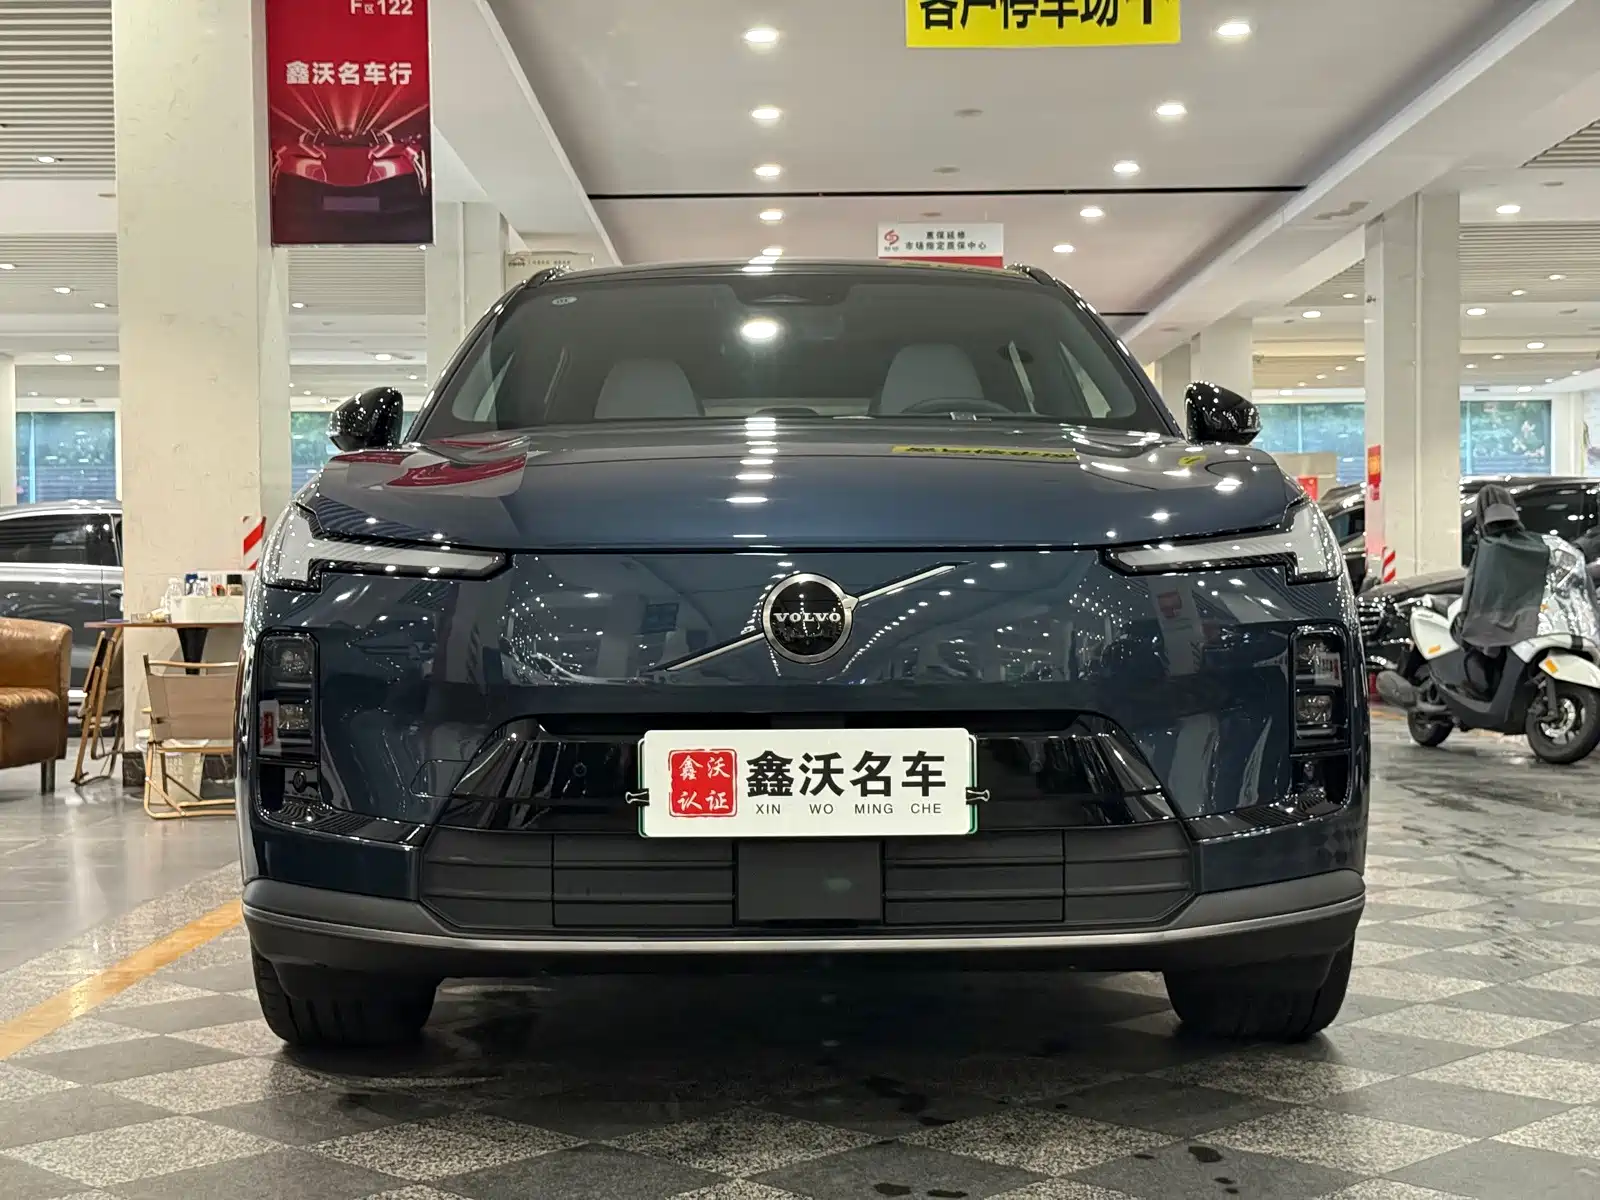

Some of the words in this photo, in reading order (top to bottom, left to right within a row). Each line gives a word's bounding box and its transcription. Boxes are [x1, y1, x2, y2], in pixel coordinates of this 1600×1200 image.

[286, 61, 413, 86] 鑫沃名车行
[773, 612, 841, 623] VOLVO
[679, 755, 731, 780] 鑫沃
[746, 750, 947, 798] 鑫沃名车
[677, 790, 730, 811] 认证
[756, 803, 781, 815] XIN
[809, 803, 834, 815] WO
[854, 803, 894, 815] MING
[910, 803, 941, 814] CHE
